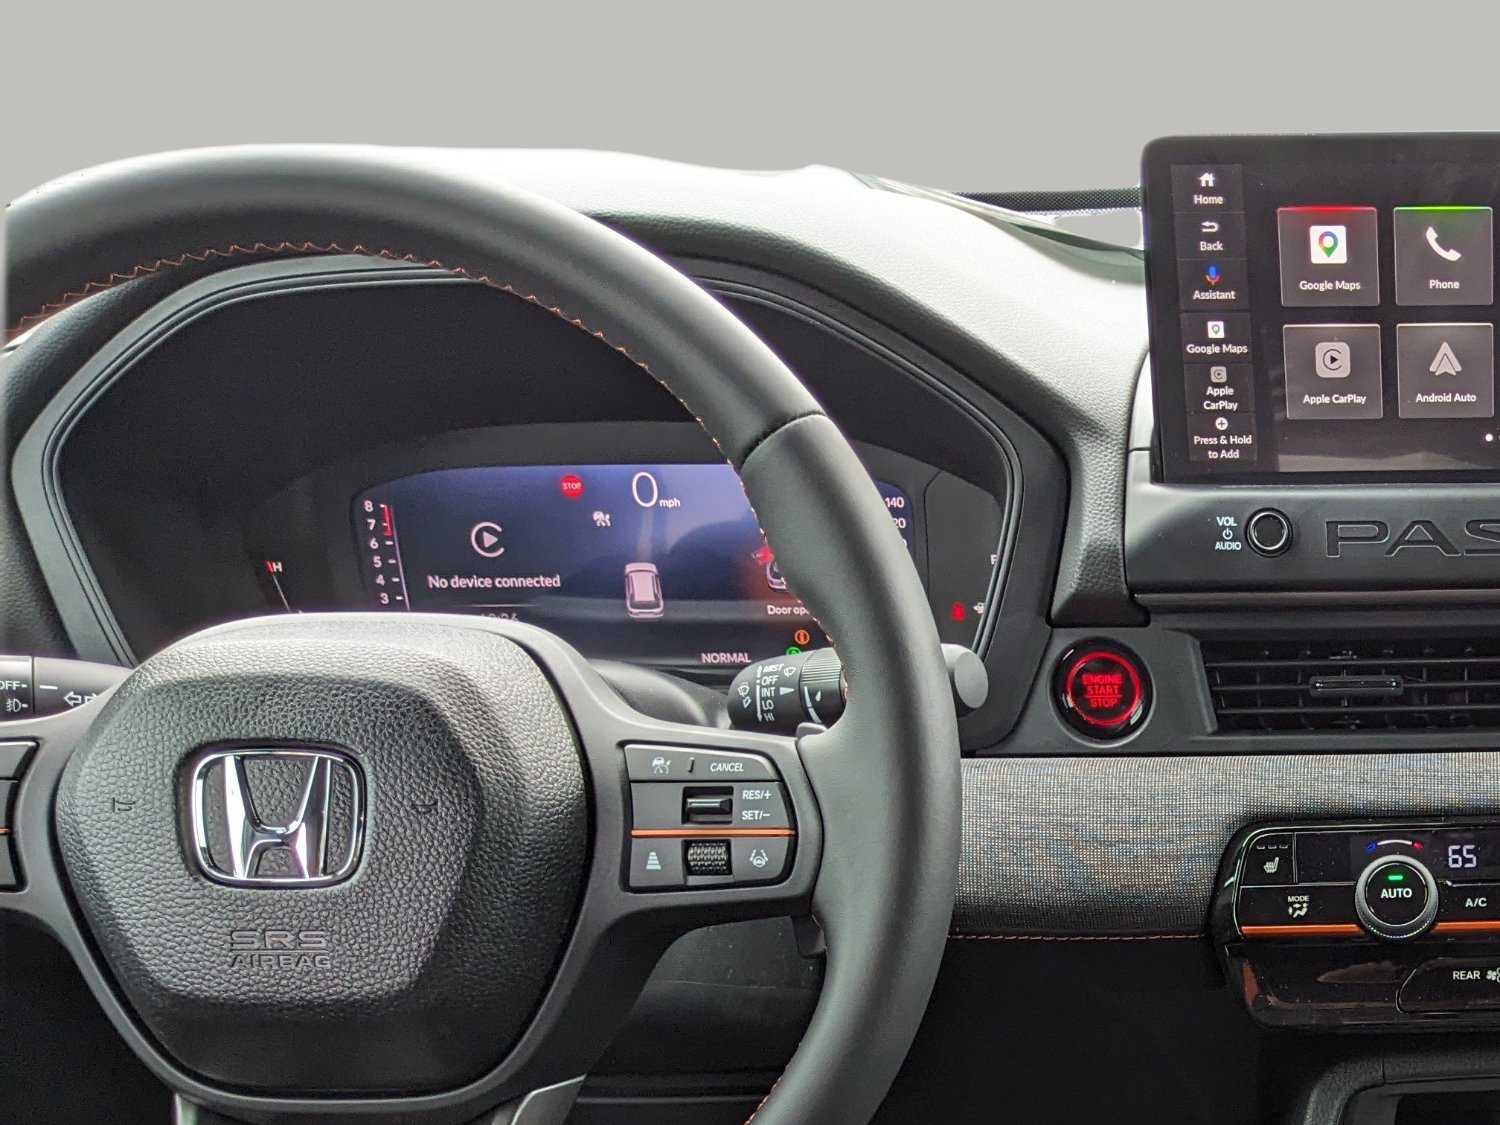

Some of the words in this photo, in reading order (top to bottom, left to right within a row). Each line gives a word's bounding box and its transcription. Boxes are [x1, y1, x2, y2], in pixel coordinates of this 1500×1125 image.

[1194, 194, 1223, 204] Home
[1200, 241, 1223, 251] Back
[1299, 280, 1333, 291] Google
[1336, 280, 1360, 291] Maps
[1429, 279, 1460, 289] Phone
[1193, 290, 1236, 300] Assistant
[1186, 344, 1220, 354] Google
[1222, 344, 1248, 354] Maps
[1206, 386, 1234, 397] Apple
[1303, 394, 1330, 405] Apple
[1332, 394, 1366, 404] CarPlay
[1416, 393, 1451, 402] Android
[1454, 393, 1476, 402] Auto
[1203, 401, 1238, 411] CarPlay
[1194, 435, 1217, 444] Press
[1220, 436, 1228, 444] &
[1230, 435, 1252, 444] Hold
[1208, 450, 1218, 458] to
[1220, 449, 1239, 458] Add
[563, 482, 582, 491] STOP
[632, 471, 658, 507] 0
[659, 497, 681, 508] mph
[364, 500, 373, 512] 8
[885, 497, 905, 508] 140
[367, 519, 376, 530] 7
[1217, 516, 1237, 526] VOL
[370, 538, 378, 549] 6
[1215, 541, 1242, 551] AUDIO
[373, 556, 382, 568] 5
[376, 574, 385, 586] 4
[428, 575, 448, 589] No
[450, 575, 492, 588] device
[495, 574, 561, 588] connected
[380, 593, 389, 604] 3
[767, 605, 791, 615] Door
[701, 652, 752, 664] NORMAL
[761, 676, 778, 685] OFF
[1082, 674, 1122, 684] ENGINE
[761, 687, 775, 697] INT
[1087, 685, 1120, 694] START
[762, 700, 774, 710] LO
[1090, 698, 1118, 708] STOP
[764, 712, 774, 721] HI
[710, 762, 744, 773] CANCEL
[742, 790, 772, 800] RES/+
[1448, 845, 1477, 868] 65
[1380, 887, 1412, 899] AUTO
[1465, 897, 1487, 908] A/C
[230, 929, 328, 949] SRS
[231, 954, 331, 968] AIRBAG
[1452, 970, 1481, 980] REAR
